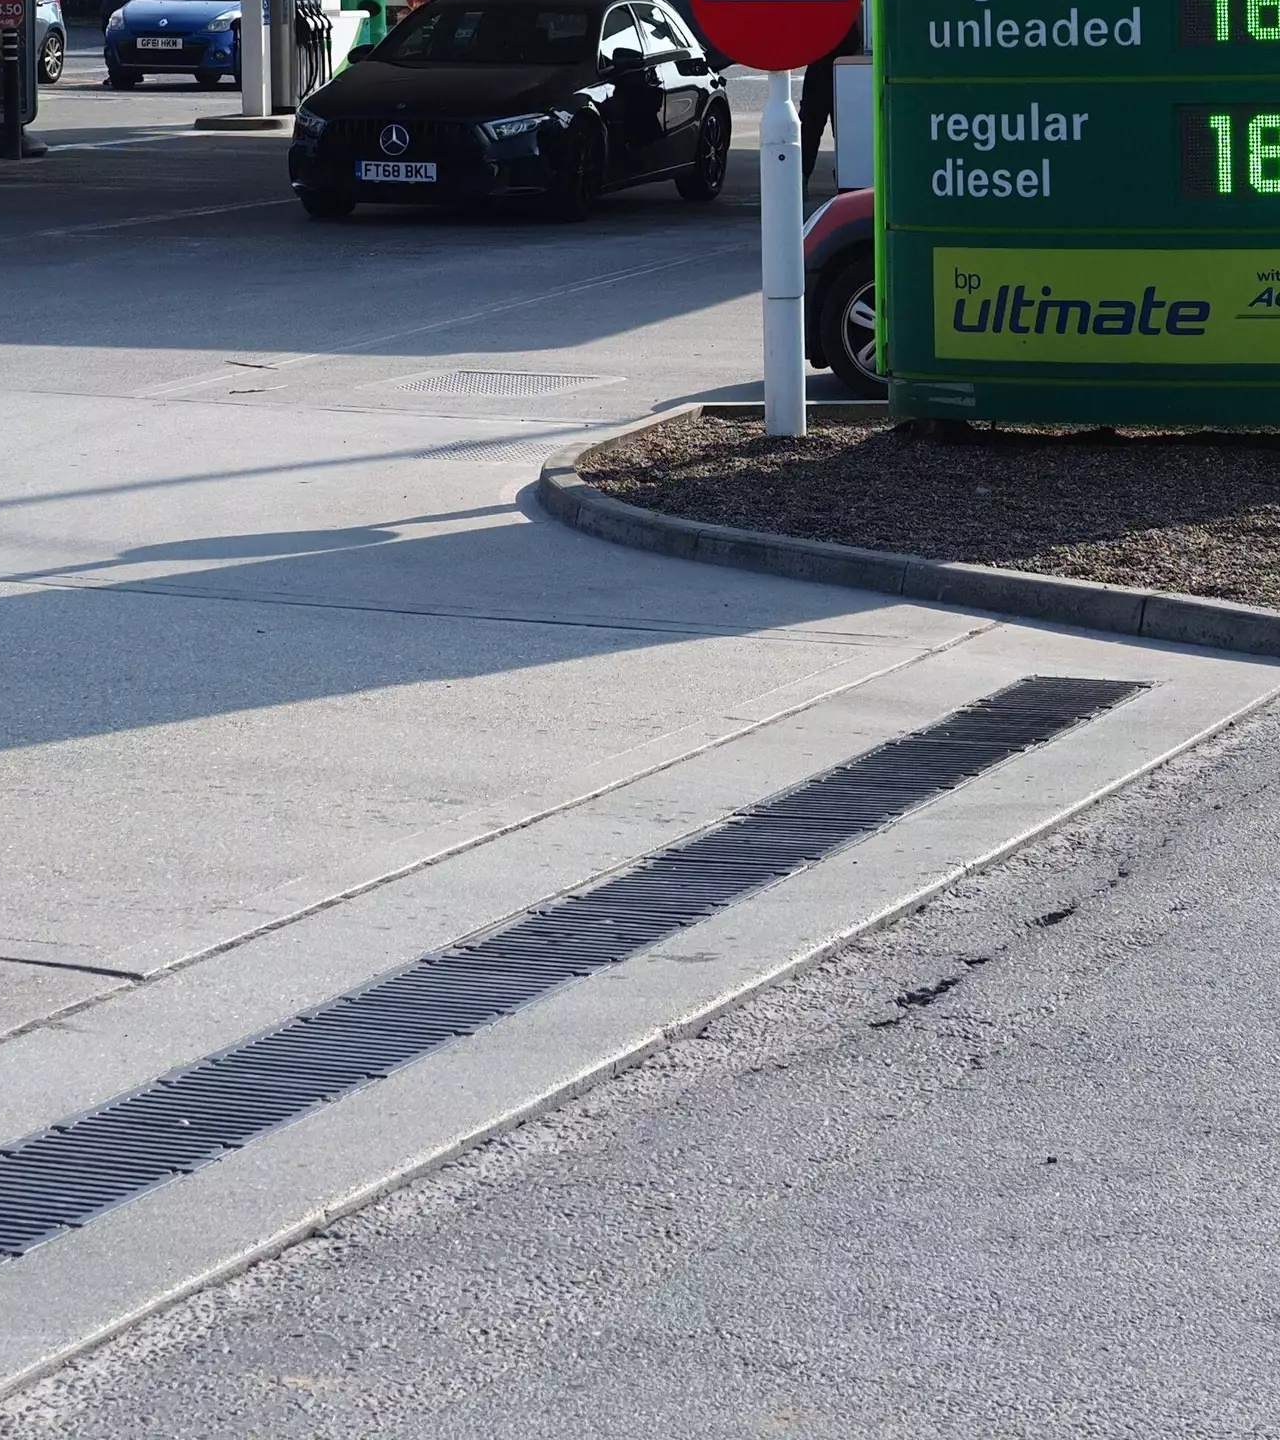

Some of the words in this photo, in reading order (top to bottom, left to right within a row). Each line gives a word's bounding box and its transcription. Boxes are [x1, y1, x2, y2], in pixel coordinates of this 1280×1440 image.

[928, 6, 1142, 49] unleaded
[930, 102, 1089, 151] regular
[364, 163, 400, 178] FT68
[404, 164, 434, 179] BKL
[931, 158, 1051, 198] diesel
[954, 267, 982, 295] bp
[952, 284, 1211, 336] ultimate
